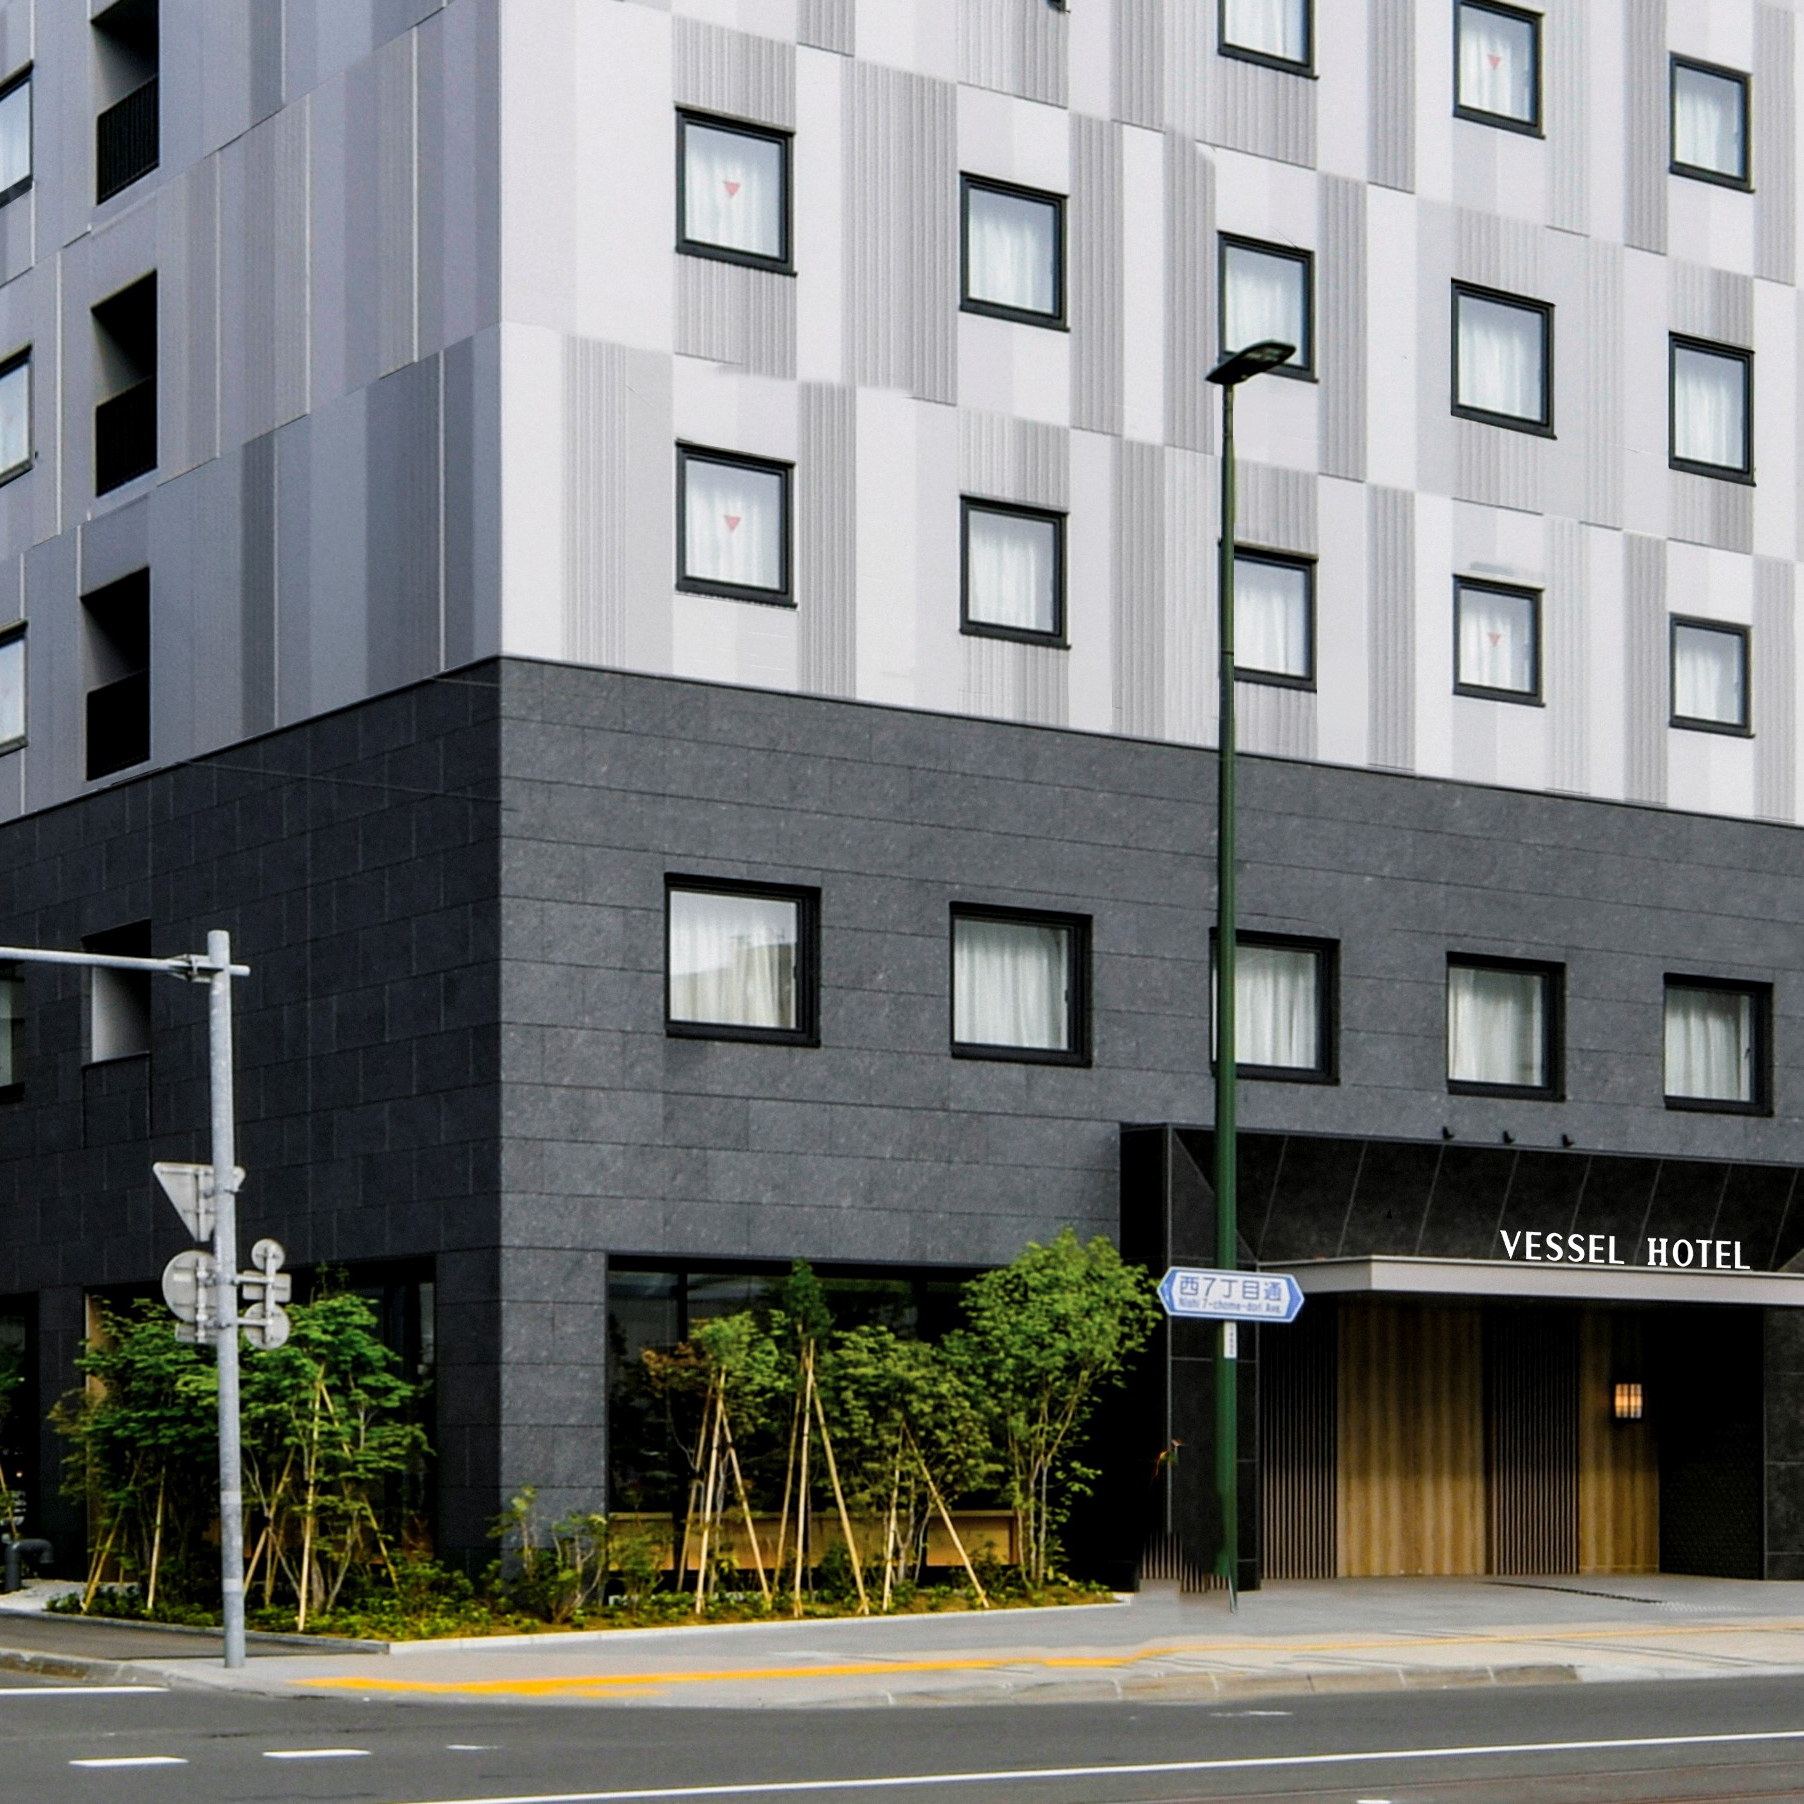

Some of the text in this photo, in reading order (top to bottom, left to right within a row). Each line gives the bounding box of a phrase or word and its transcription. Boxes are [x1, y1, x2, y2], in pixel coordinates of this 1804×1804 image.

[1500, 1229, 1751, 1270] VESSEL HOTEL
[1179, 1275, 1282, 1302] 西7丁目通
